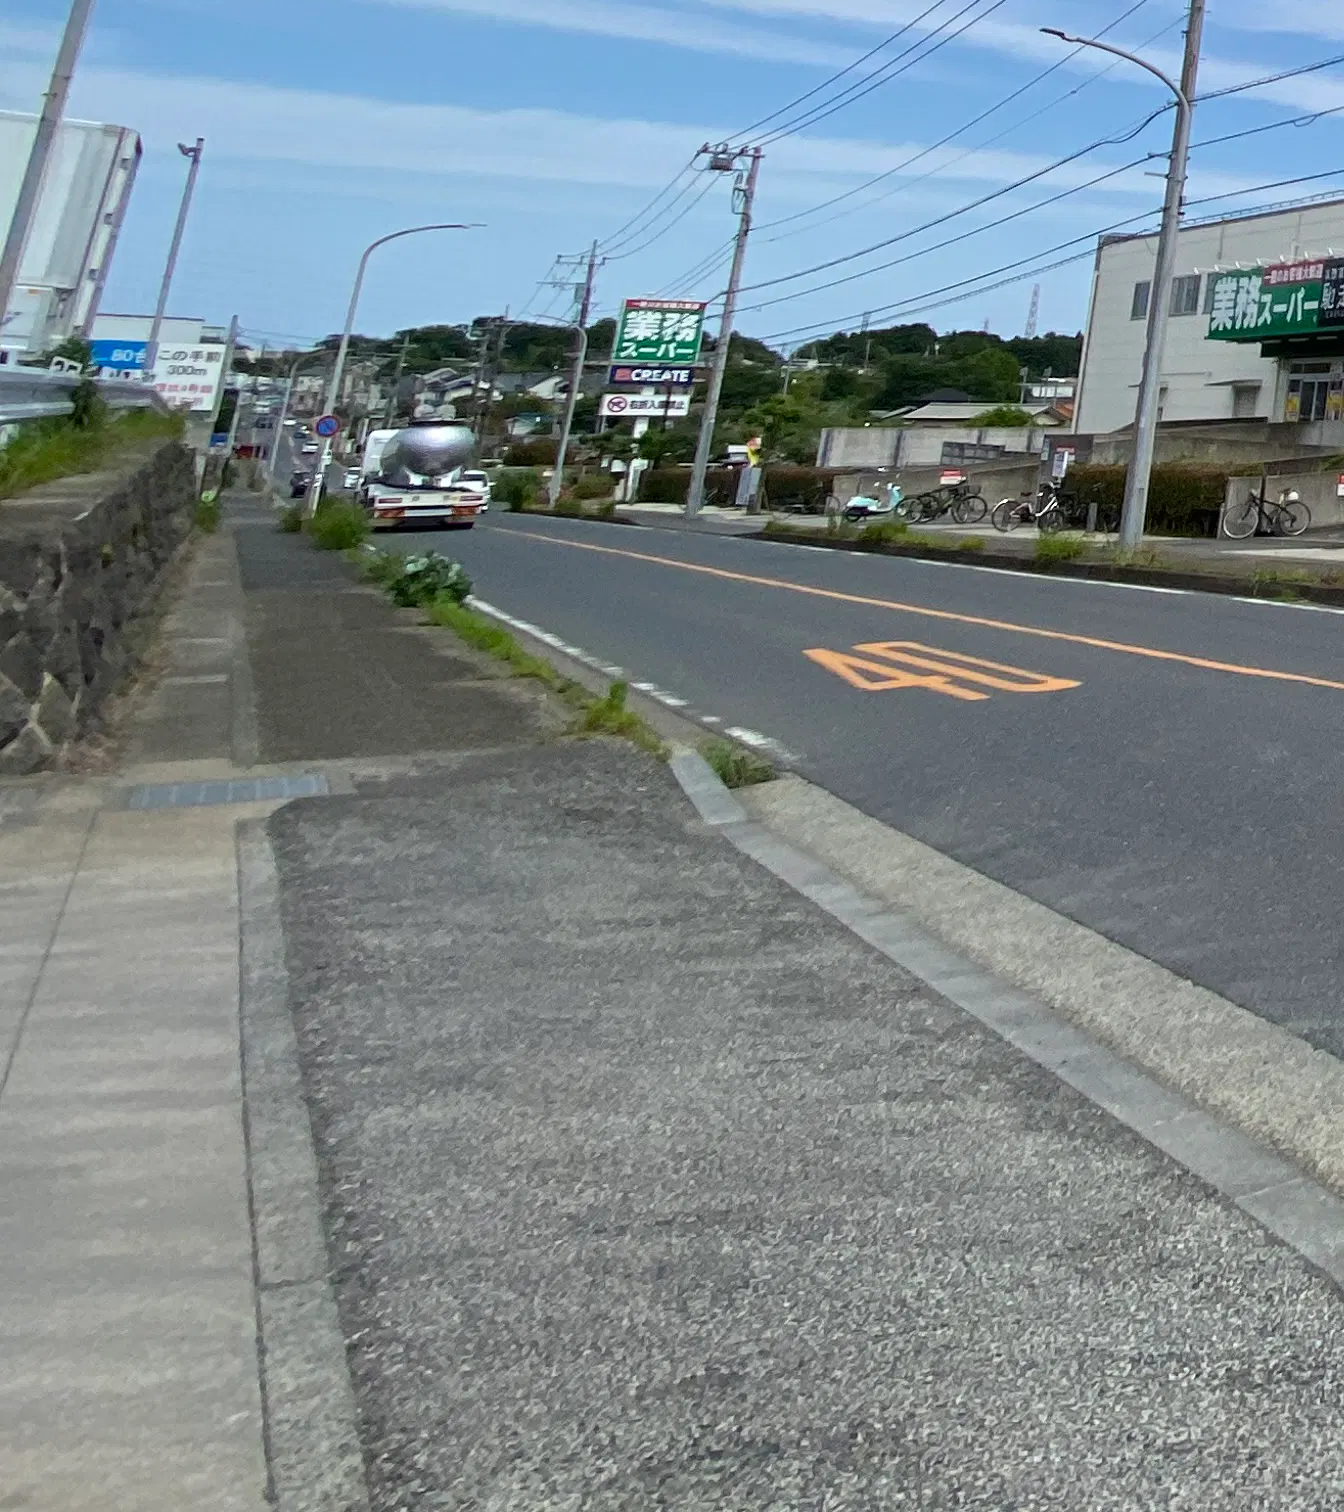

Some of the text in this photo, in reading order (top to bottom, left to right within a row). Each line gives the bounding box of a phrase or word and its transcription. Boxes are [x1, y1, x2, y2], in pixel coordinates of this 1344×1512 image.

[1211, 275, 1320, 331] 業務スーパー
[623, 310, 700, 342] 業務
[620, 342, 695, 358] スーパー
[631, 368, 691, 383] CREATE
[801, 640, 1085, 701] 40
